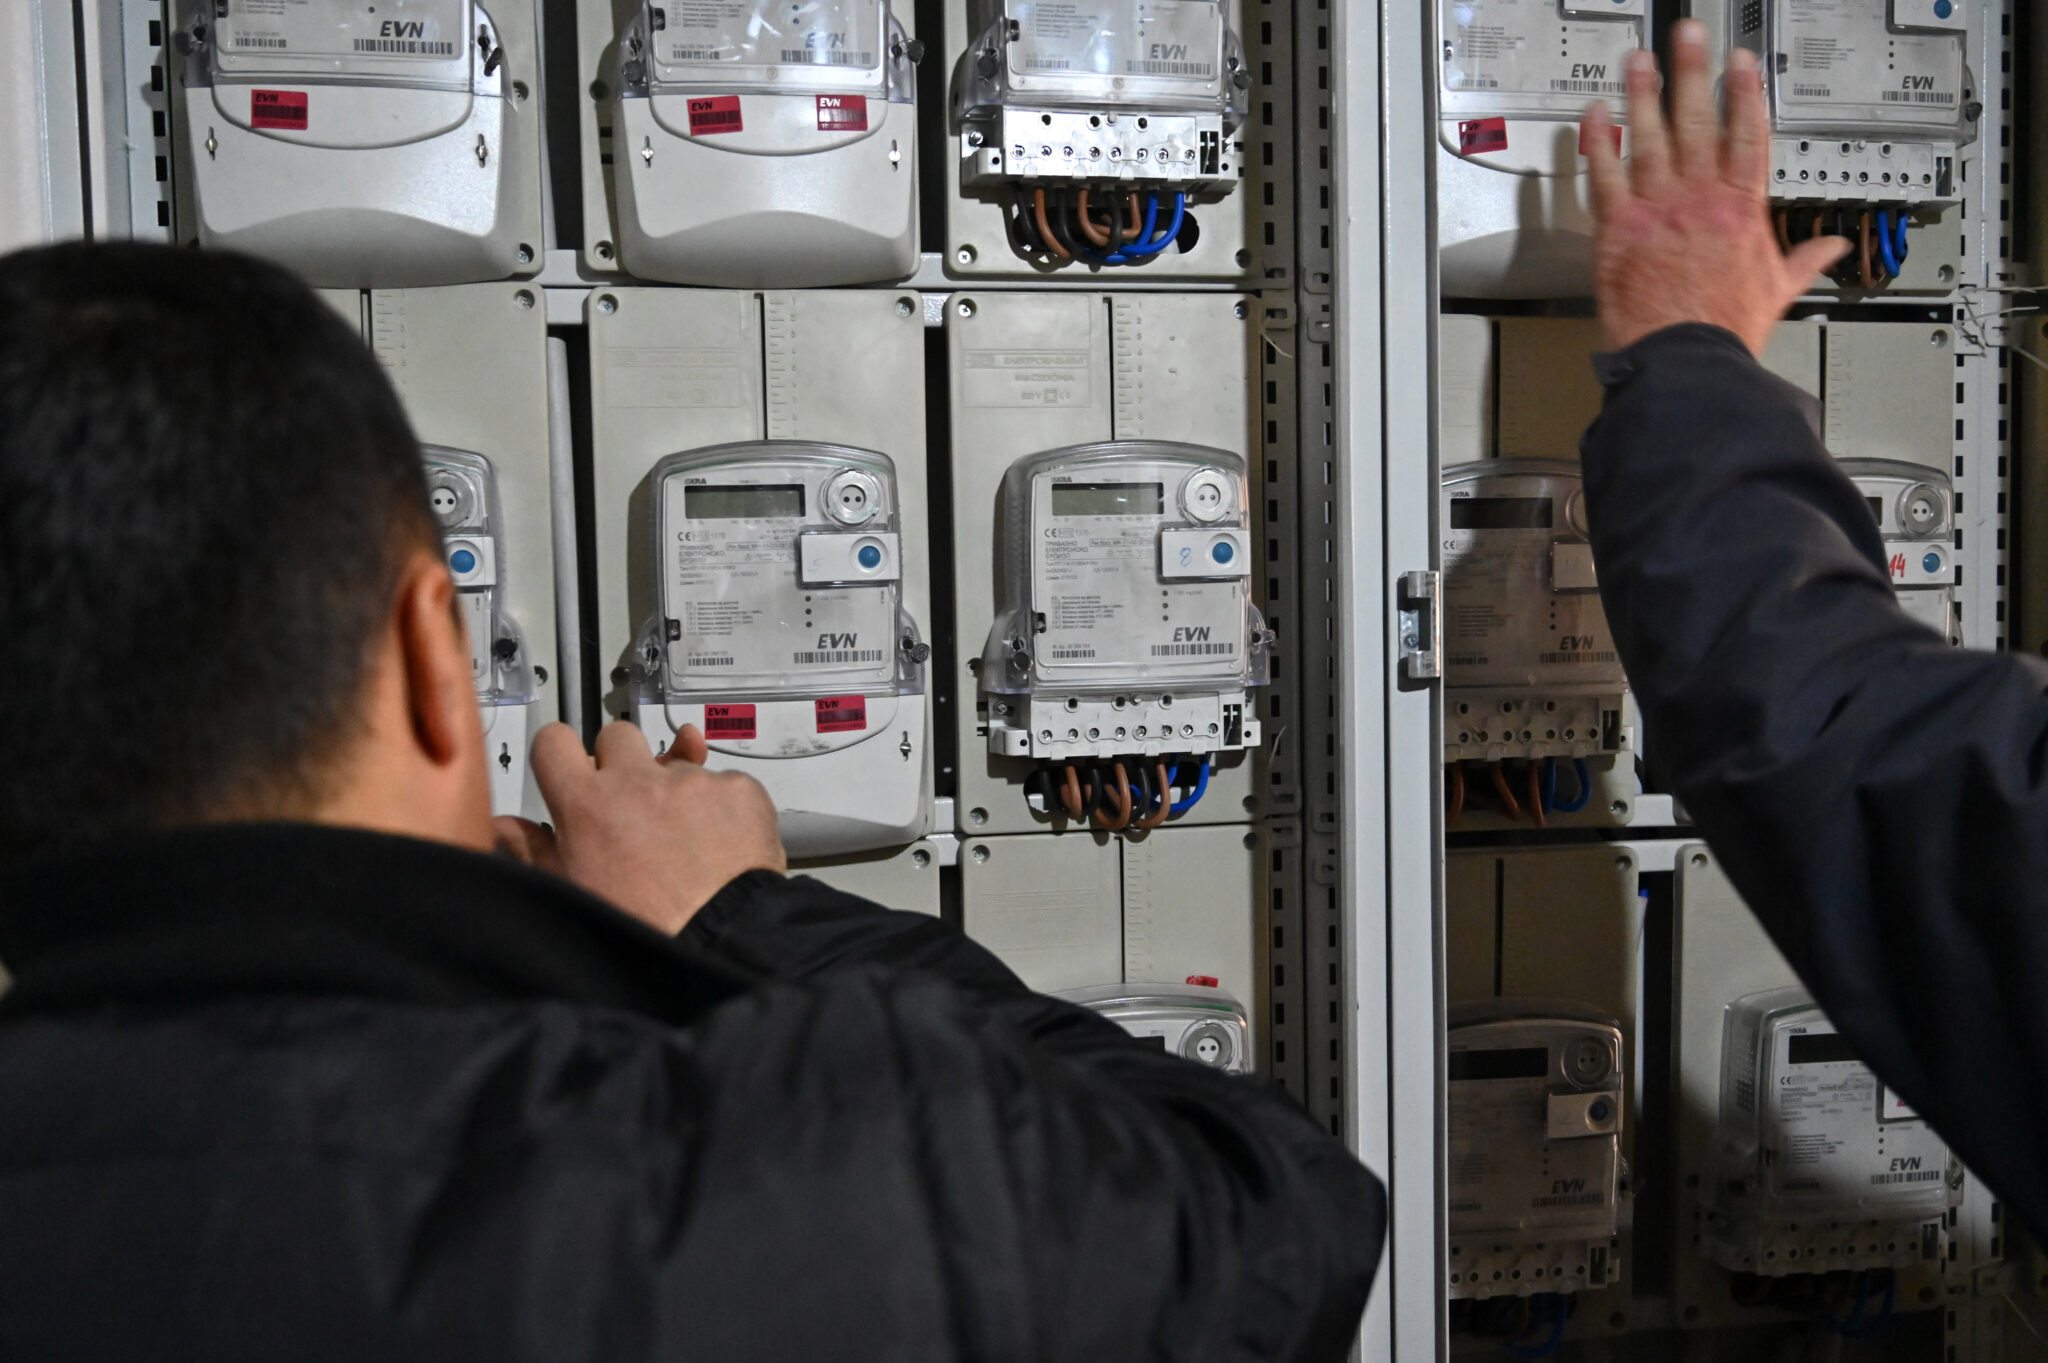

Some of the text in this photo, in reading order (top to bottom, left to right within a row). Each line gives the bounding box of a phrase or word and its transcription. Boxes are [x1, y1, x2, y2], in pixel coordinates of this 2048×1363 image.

[380, 20, 425, 39] EVN
[1150, 43, 1188, 60] EVN
[1571, 63, 1607, 80] EVN
[1902, 75, 1935, 90] EVN
[691, 101, 713, 112] EVN
[820, 97, 841, 107] EVN
[1179, 547, 1192, 567] 8
[817, 632, 858, 649] EVN
[1173, 626, 1211, 642] EVN
[1559, 635, 1594, 650] EVN
[708, 707, 729, 716] EVN
[819, 700, 840, 710] EVN
[1889, 1157, 1922, 1172] EVN
[1551, 1178, 1586, 1194] EVN
